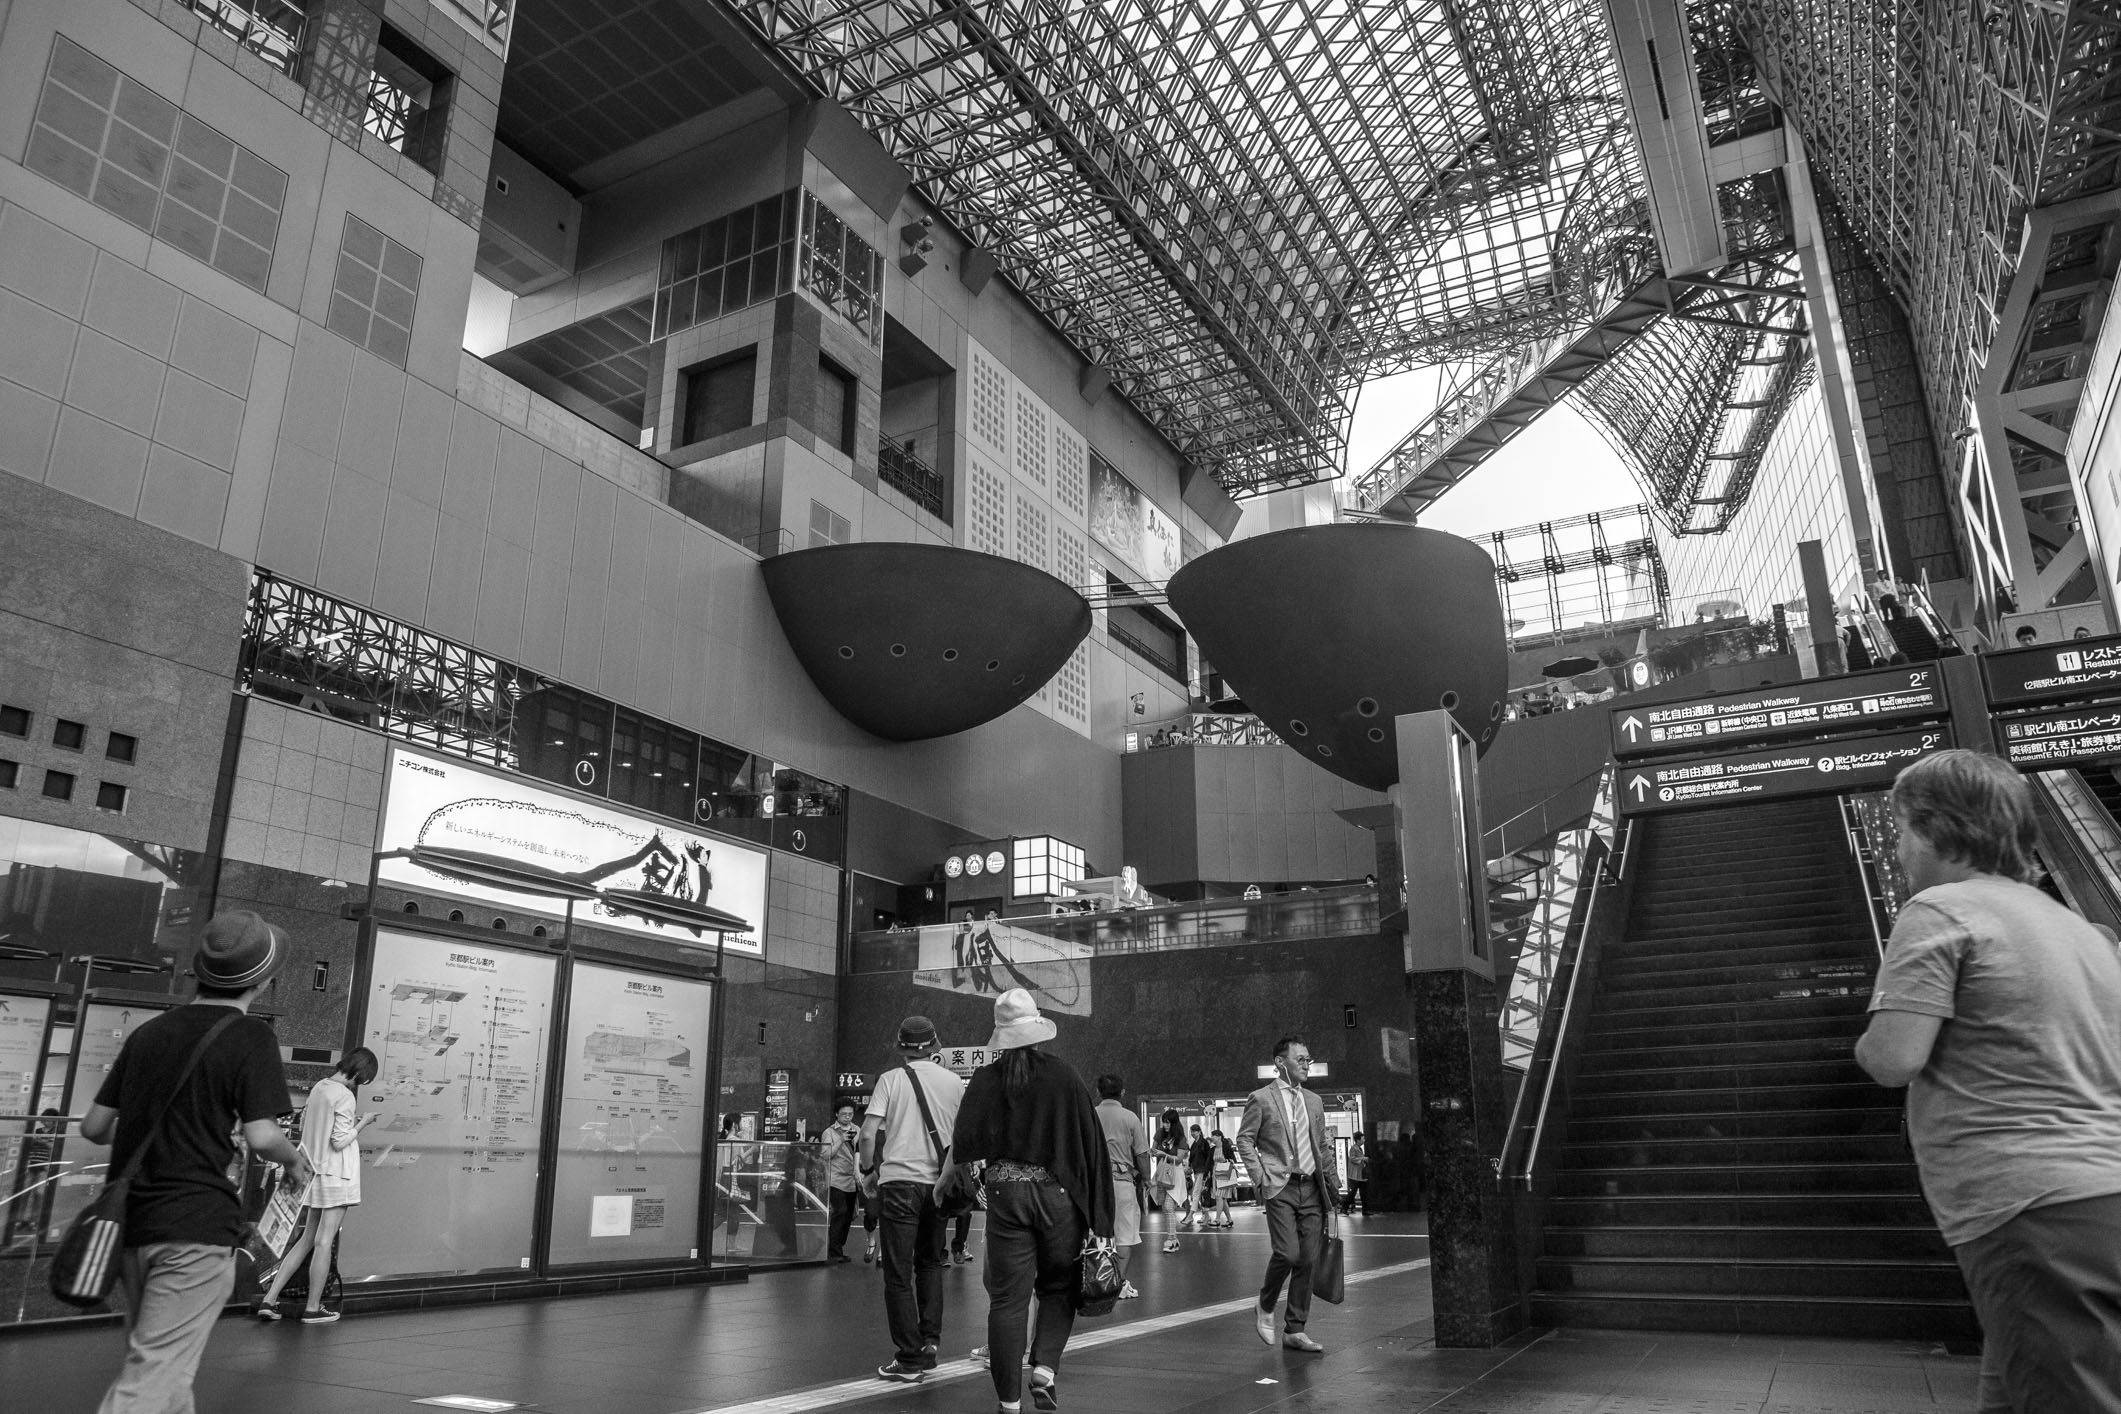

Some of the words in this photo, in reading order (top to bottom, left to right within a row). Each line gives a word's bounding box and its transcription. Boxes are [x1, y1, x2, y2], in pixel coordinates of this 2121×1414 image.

[1648, 704, 1715, 723] 南北自由通路
[1718, 702, 1762, 714] Pedestrian
[1762, 697, 1800, 708] Walkway
[2071, 746, 2106, 756] Passport
[1656, 764, 1724, 783] 南北自由通路
[1726, 762, 1771, 774] Pedestrian
[1772, 757, 1810, 768] Walkway
[1852, 760, 1887, 769] Information
[450, 952, 496, 968] 京都駅ビル案内
